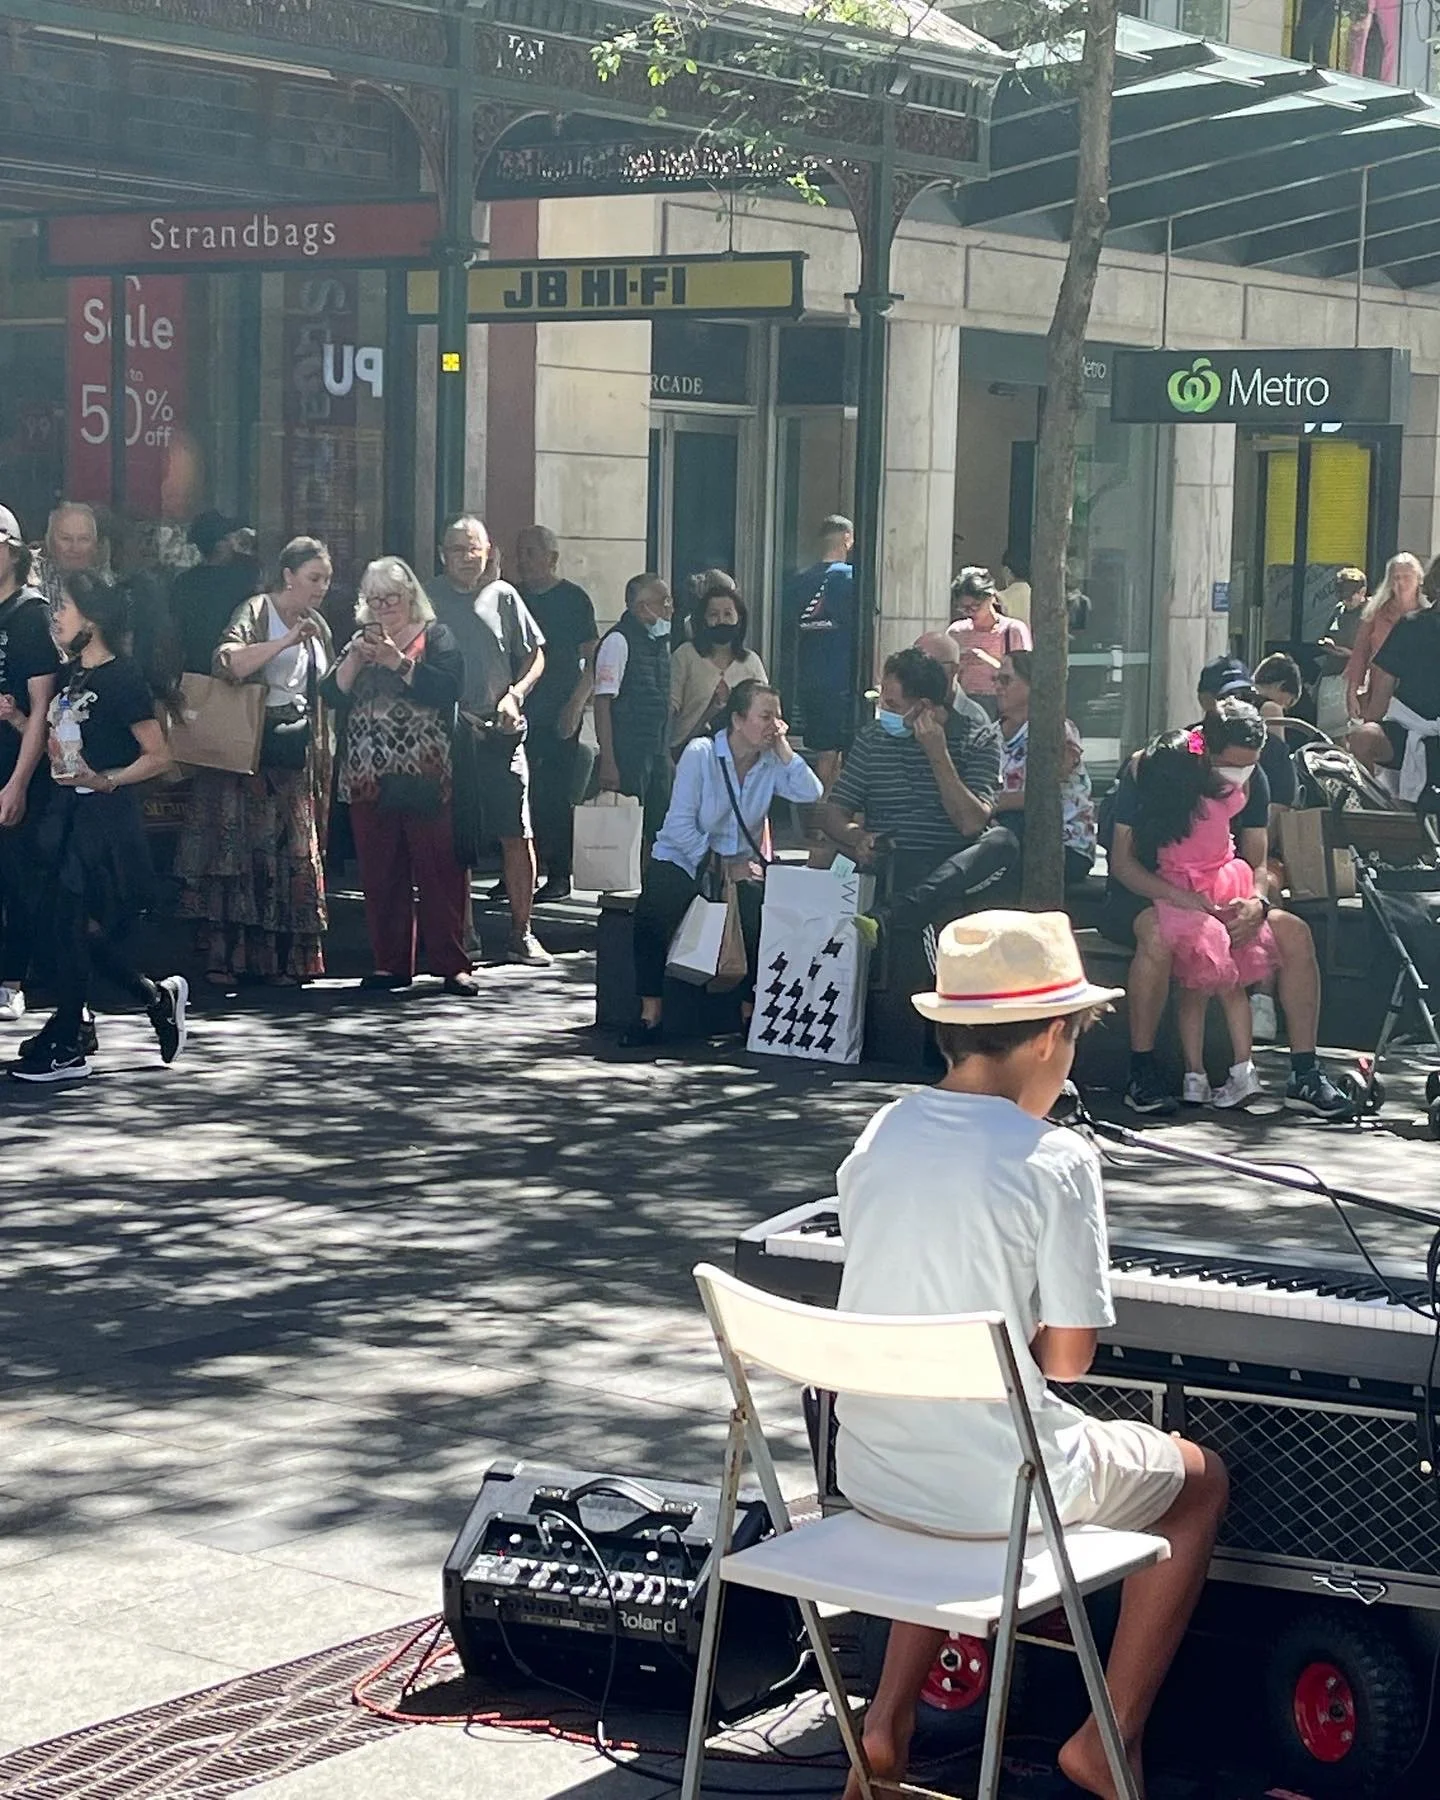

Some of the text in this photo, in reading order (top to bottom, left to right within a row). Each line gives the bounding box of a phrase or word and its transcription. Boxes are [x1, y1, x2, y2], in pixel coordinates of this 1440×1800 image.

[150, 213, 336, 256] Strandbags
[503, 270, 568, 309] JB
[1082, 356, 1107, 380] etro
[1228, 367, 1330, 407] Metro
[144, 425, 174, 448] off
